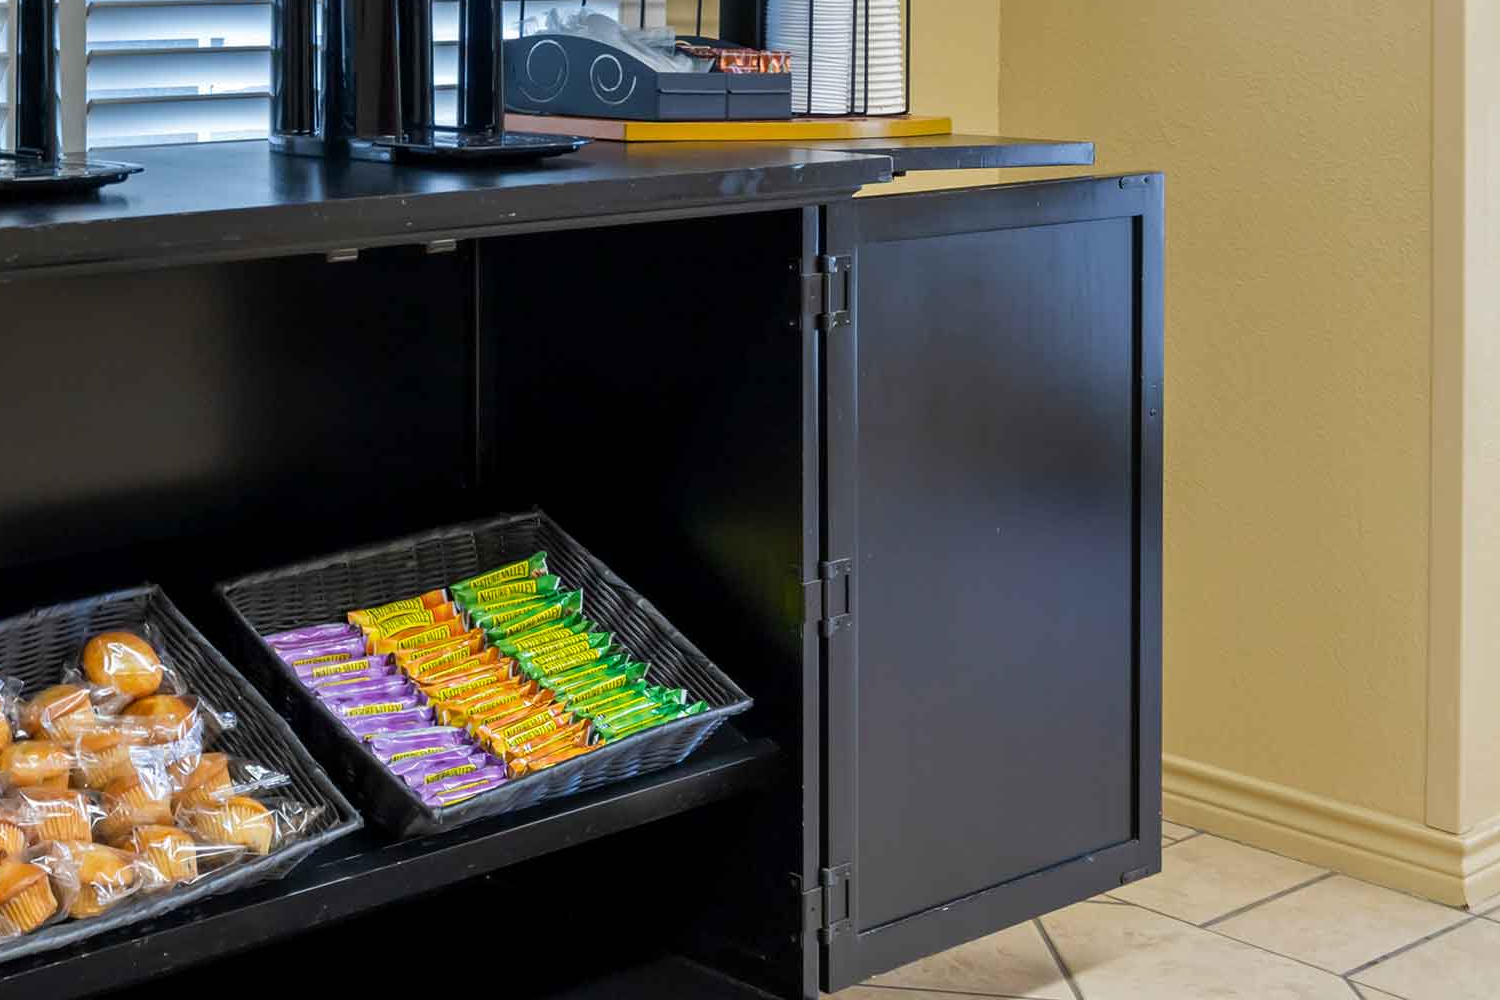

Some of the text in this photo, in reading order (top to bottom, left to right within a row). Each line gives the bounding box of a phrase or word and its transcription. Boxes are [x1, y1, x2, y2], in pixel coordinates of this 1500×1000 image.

[501, 562, 528, 580] VALLEY
[480, 581, 534, 602] NATURE VALLEY
[536, 605, 561, 626] VALLEY
[399, 627, 449, 649] NATURE VALLEY
[342, 660, 368, 672] VALLEY
[445, 650, 469, 666] VALLEY
